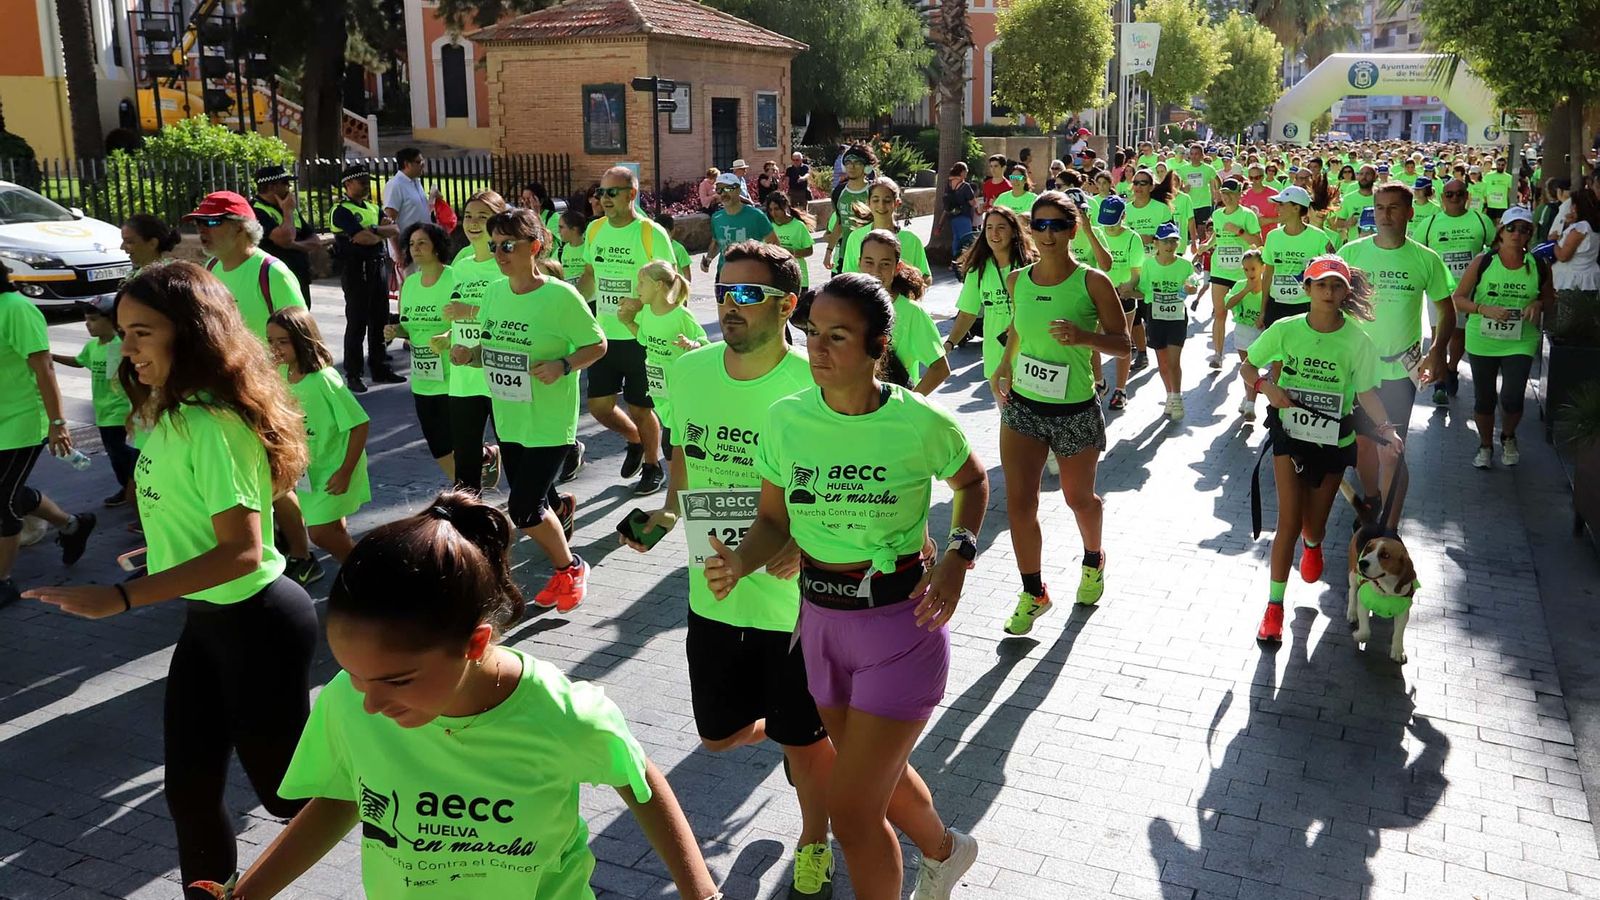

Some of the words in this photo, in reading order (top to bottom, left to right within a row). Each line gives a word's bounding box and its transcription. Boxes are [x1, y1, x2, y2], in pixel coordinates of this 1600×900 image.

[608, 246, 631, 254] aecc
[1379, 270, 1409, 280] aecc
[467, 280, 488, 288] aecc
[602, 295, 624, 304] 118
[500, 320, 528, 332] aecc
[1488, 321, 1516, 330] 1157
[459, 328, 480, 340] 103
[506, 336, 532, 346] marcha
[648, 336, 667, 346] aecc
[497, 354, 521, 364] aecc
[1303, 357, 1336, 371] aecc
[413, 360, 437, 370] 1037
[1024, 362, 1058, 382] 1057
[490, 372, 522, 388] 1034
[1312, 374, 1340, 384] marcha
[1304, 394, 1333, 404] aecc
[1292, 412, 1330, 428] 1077
[717, 443, 746, 454] HUELVA
[714, 453, 728, 462] en
[732, 456, 754, 466] mar
[714, 467, 740, 477] Contra
[828, 464, 888, 482] aecc
[716, 496, 755, 508] aecc
[825, 492, 842, 502] en
[846, 490, 899, 504] marcha
[797, 508, 826, 517] Marcha
[828, 508, 856, 517] Contra
[868, 510, 898, 518] Cáncer
[416, 792, 514, 824] aecc
[418, 822, 478, 838] HUELVA
[413, 838, 446, 852] en
[448, 836, 538, 856] marcha
[418, 858, 467, 871] Contra
[472, 858, 484, 866] el
[490, 859, 540, 873] Cáncer
